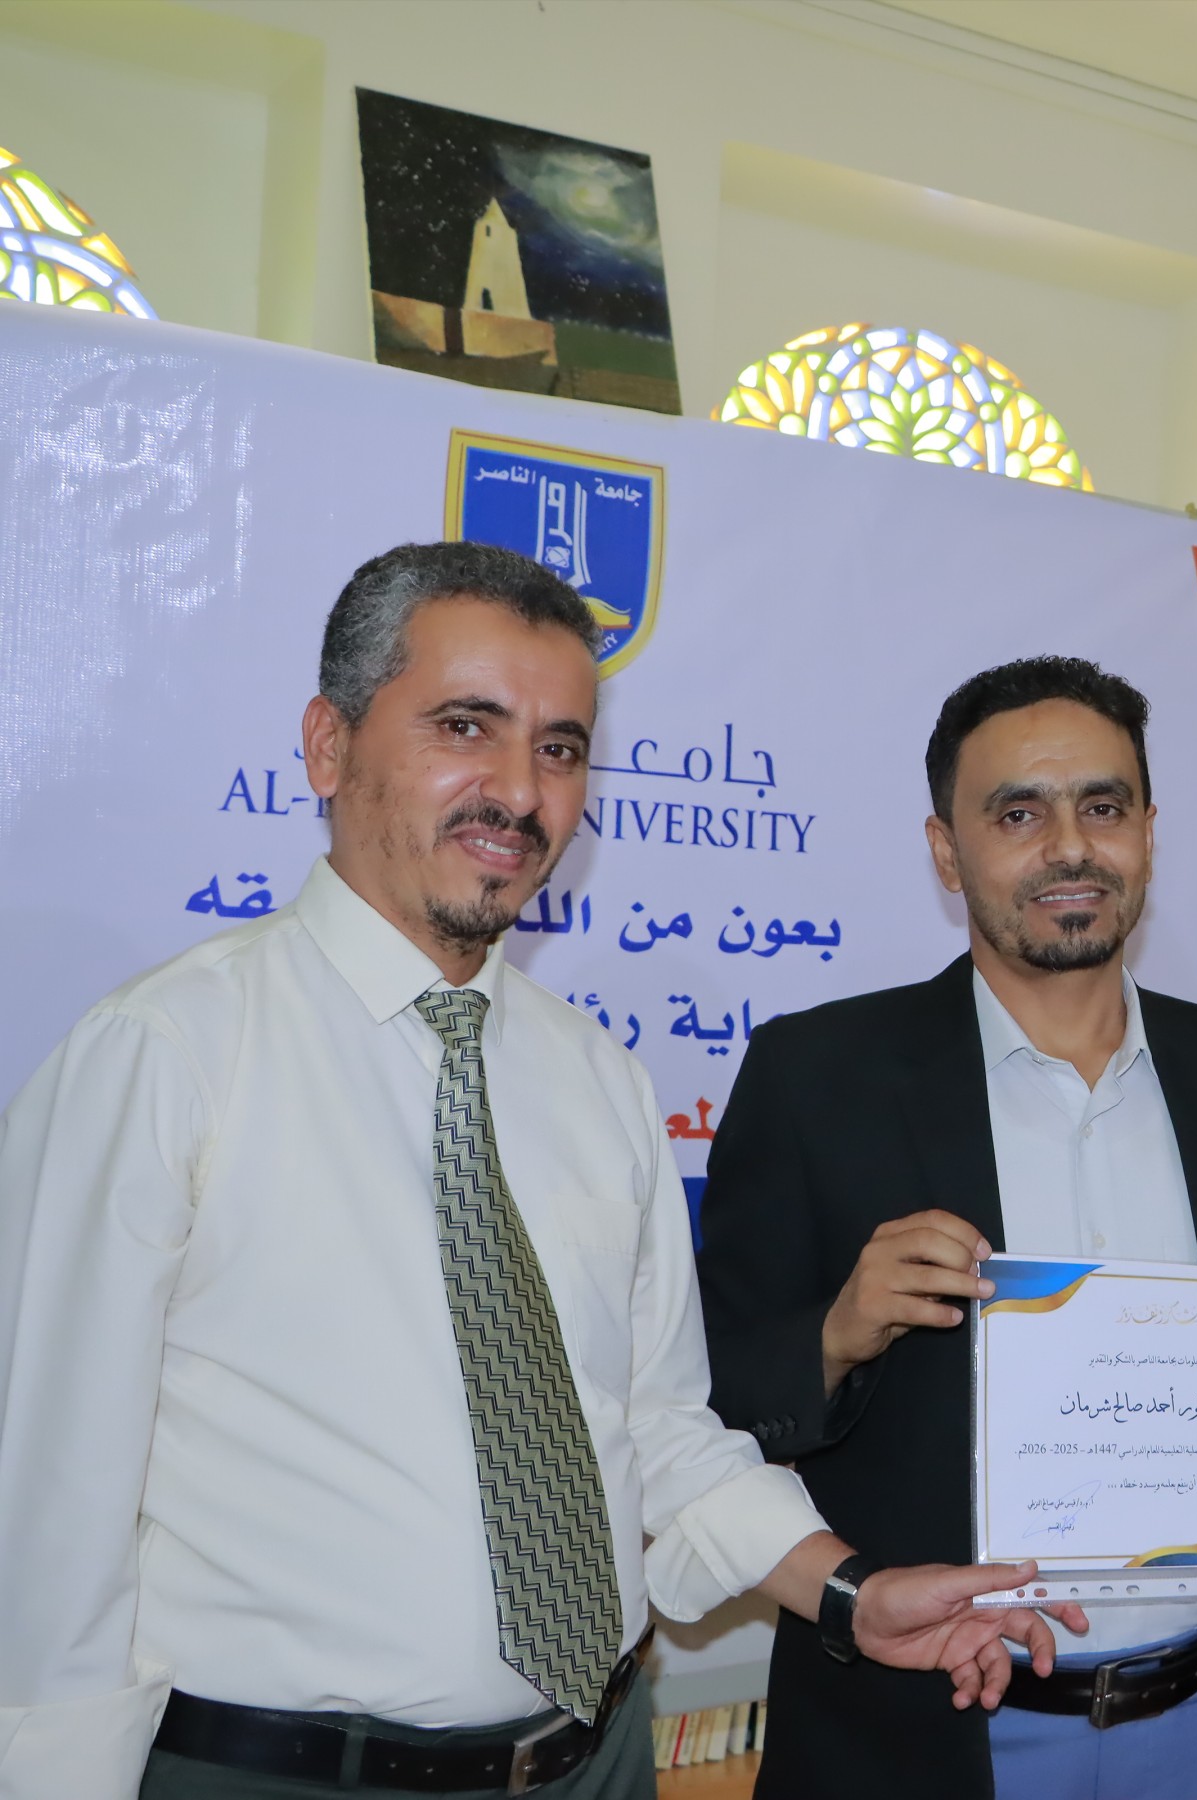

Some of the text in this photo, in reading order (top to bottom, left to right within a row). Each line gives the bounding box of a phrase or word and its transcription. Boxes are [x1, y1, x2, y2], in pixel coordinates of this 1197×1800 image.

[474, 465, 643, 507] جامعة الناصر
[589, 723, 777, 798] جامع
[574, 797, 816, 854] NIVERSITY
[514, 886, 591, 935] الل
[619, 901, 694, 953] من
[718, 905, 842, 962] بعون
[1088, 1353, 1113, 1369] والتقدير
[1113, 1351, 1136, 1368] بالشكر
[1137, 1355, 1157, 1367] الناصر
[1060, 1391, 1112, 1419] شرمان
[1112, 1391, 1143, 1423] صالح
[1146, 1386, 1175, 1413] أحمد
